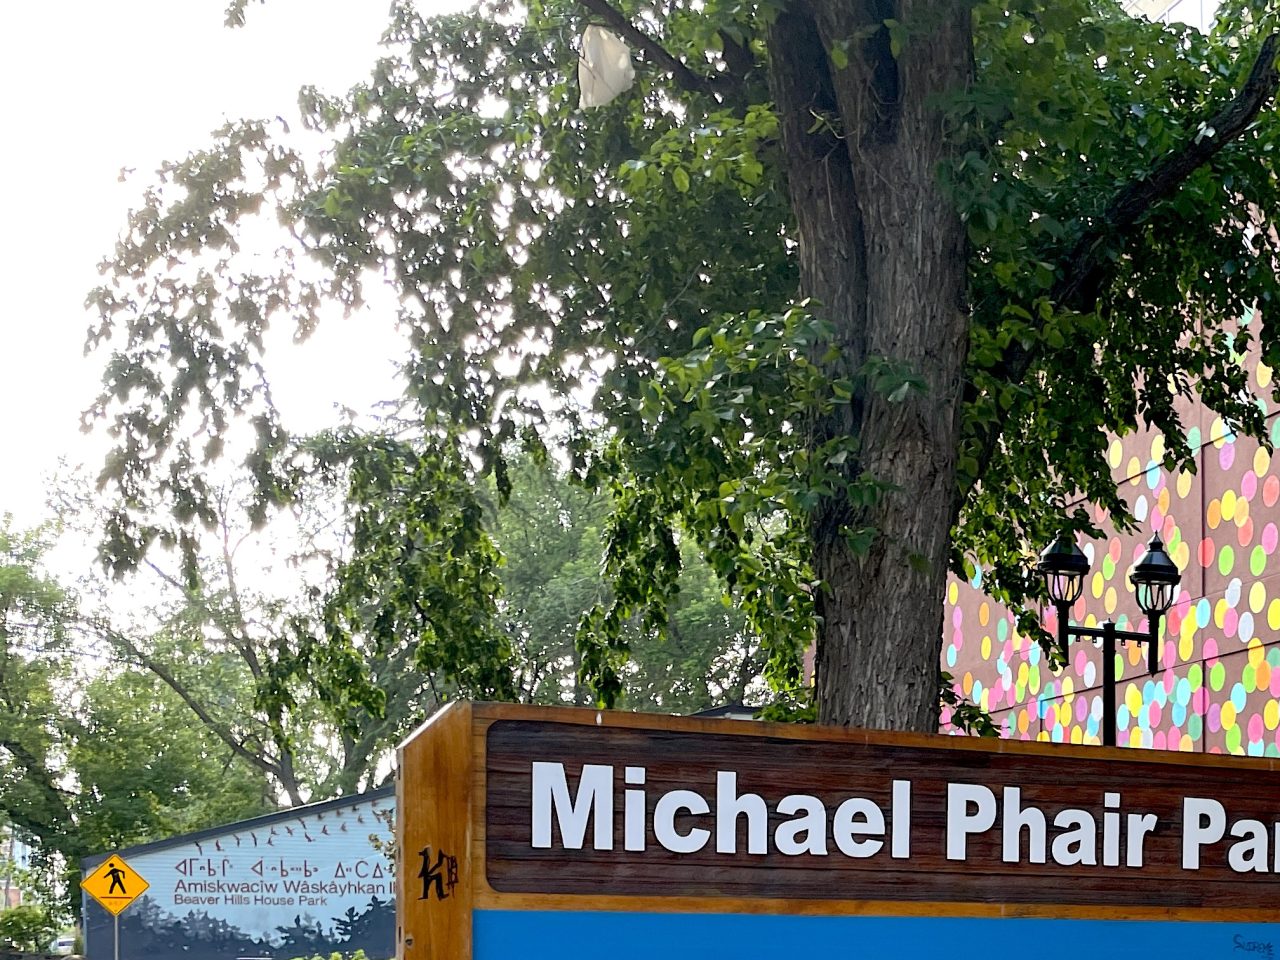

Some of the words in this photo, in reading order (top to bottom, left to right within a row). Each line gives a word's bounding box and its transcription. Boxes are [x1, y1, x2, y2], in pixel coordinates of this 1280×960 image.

[531, 761, 911, 859] Michael
[946, 782, 1159, 868] Phair
[283, 880, 386, 898] Wâskâyhkan
[174, 894, 220, 905] Beaver
[224, 894, 250, 905] Hills
[254, 895, 295, 906] House
[298, 895, 328, 907] Park
